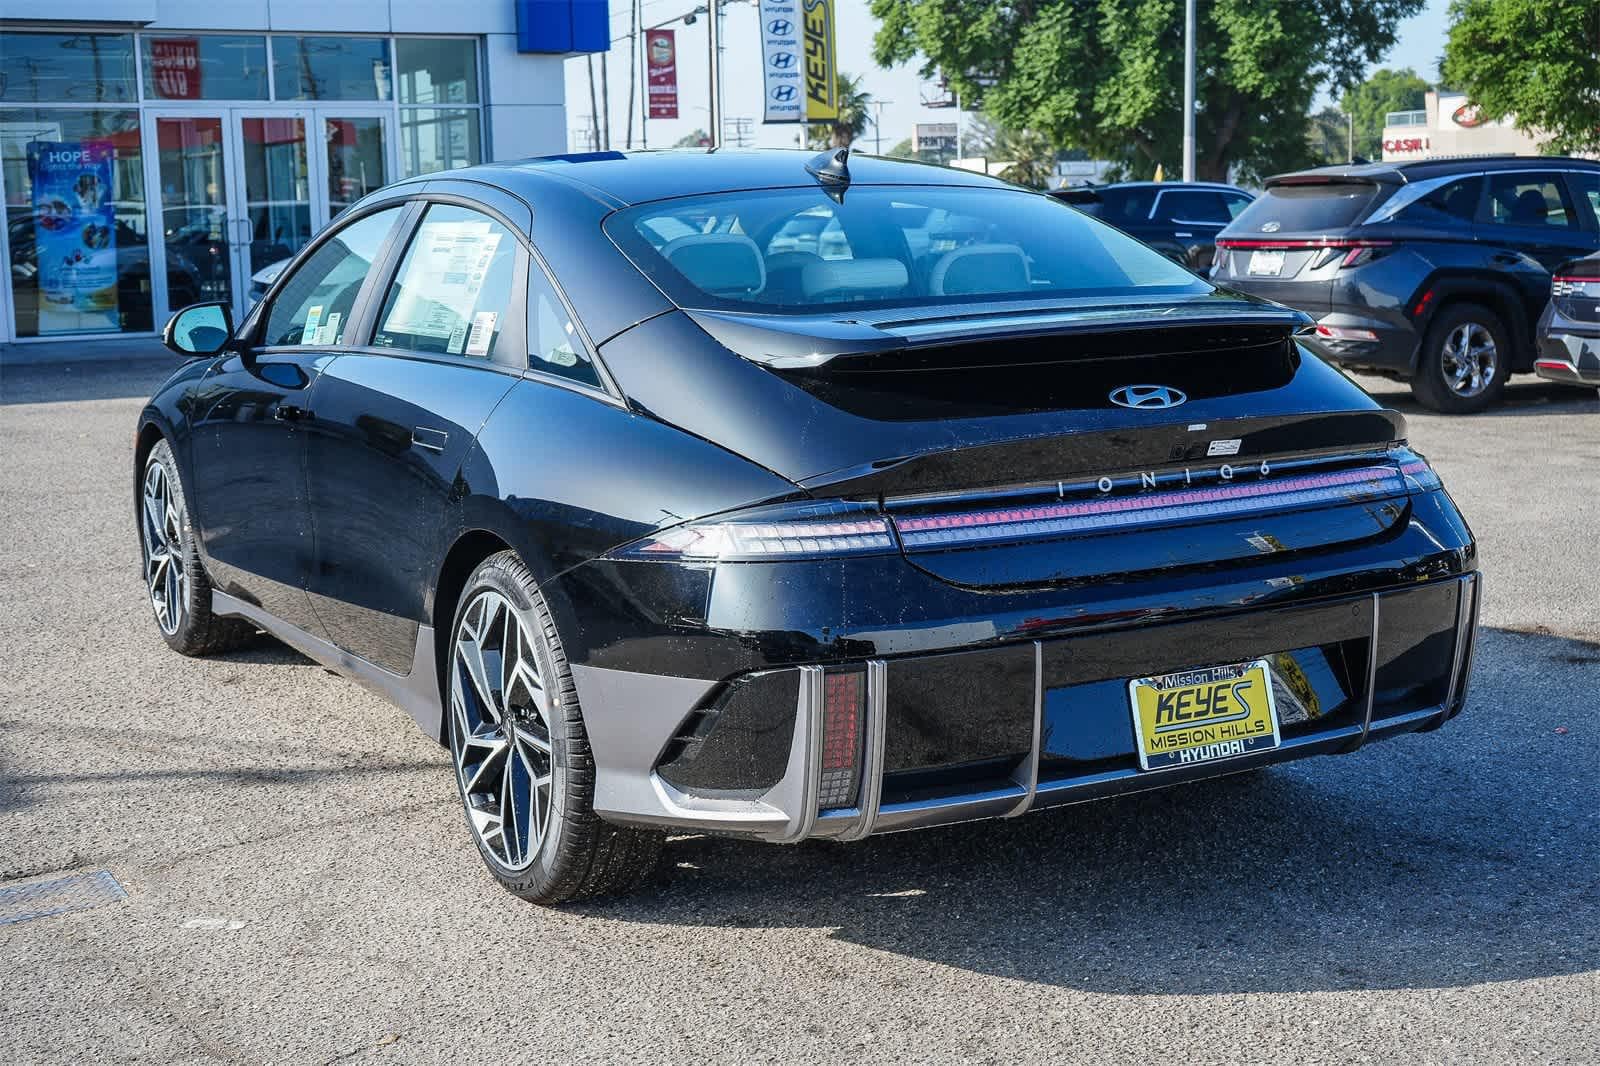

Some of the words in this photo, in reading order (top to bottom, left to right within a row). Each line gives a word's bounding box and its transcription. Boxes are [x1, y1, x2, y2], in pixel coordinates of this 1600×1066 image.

[49, 151, 91, 162] HOPE
[1164, 671, 1208, 689] Mission
[1212, 667, 1236, 682] Hills
[1155, 680, 1252, 727] KEYES
[1150, 728, 1215, 750] MISSION
[1221, 720, 1265, 738] HILLS
[1180, 740, 1245, 762] HYUNDAI
